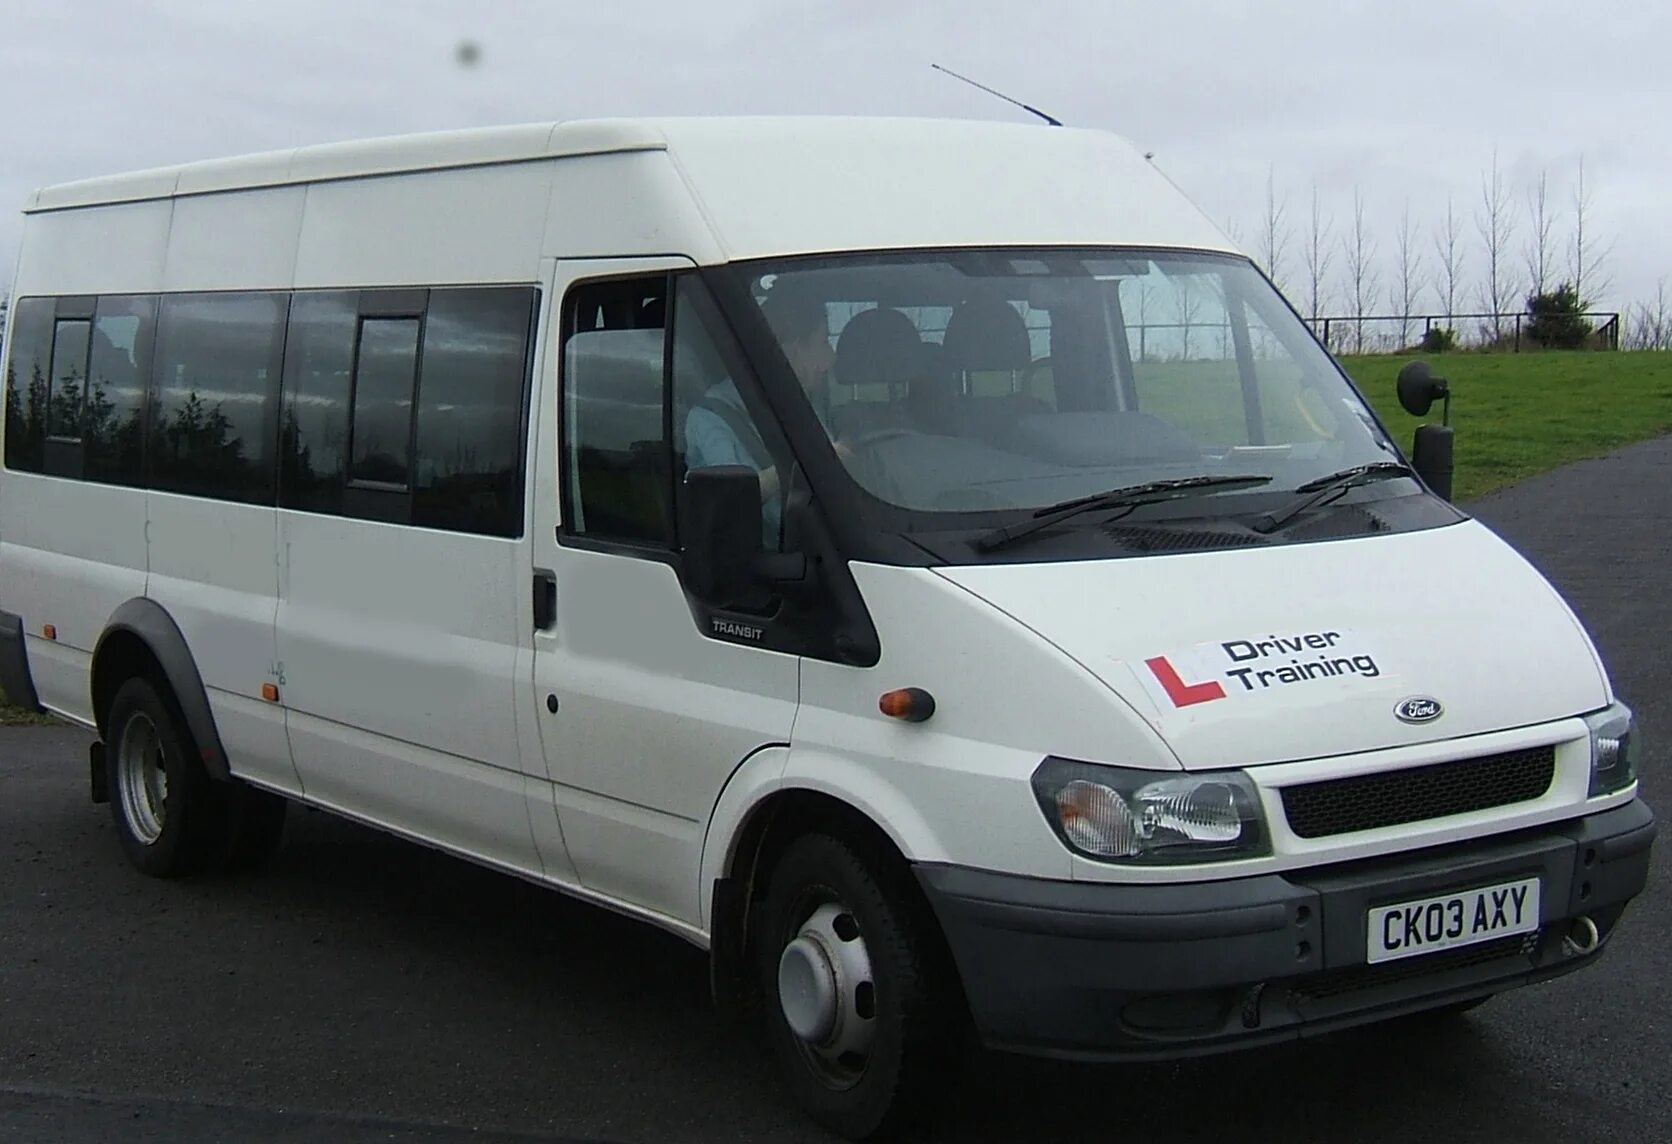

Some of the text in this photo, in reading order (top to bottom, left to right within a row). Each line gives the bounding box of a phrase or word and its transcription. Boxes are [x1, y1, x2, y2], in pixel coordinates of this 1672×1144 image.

[712, 620, 763, 640] TRANSIT
[1221, 630, 1340, 662] Driver
[1145, 655, 1228, 708] L
[1226, 653, 1380, 691] Training
[1408, 700, 1435, 717] Ford
[1383, 885, 1527, 950] CK03 AXY
